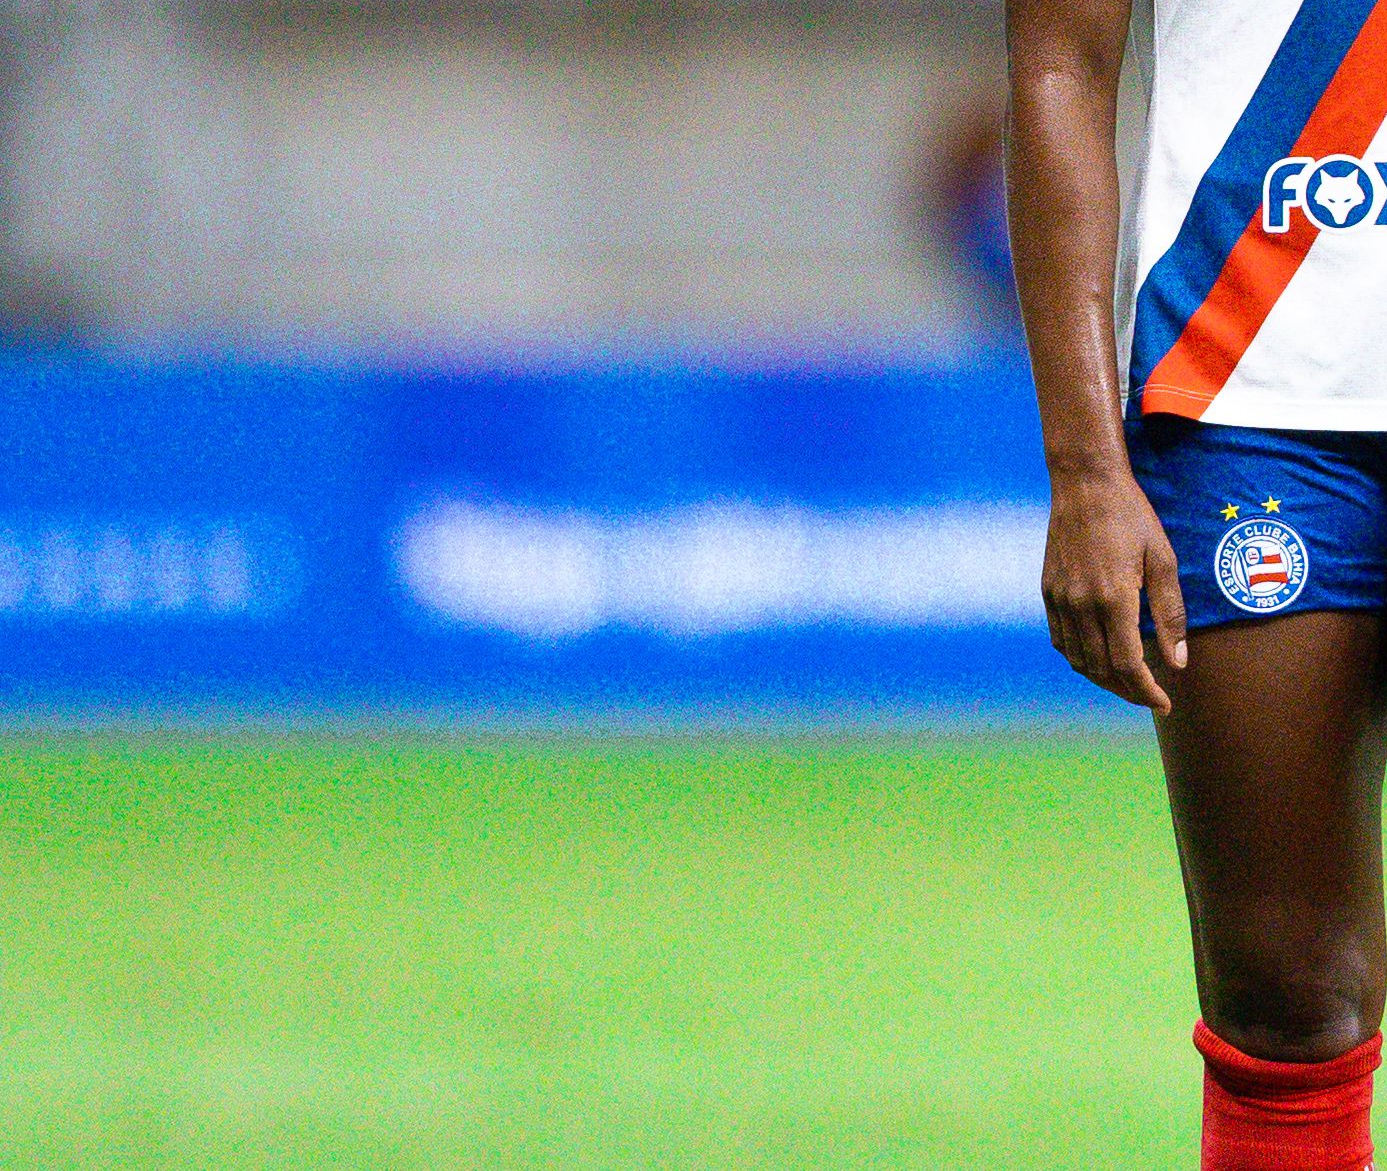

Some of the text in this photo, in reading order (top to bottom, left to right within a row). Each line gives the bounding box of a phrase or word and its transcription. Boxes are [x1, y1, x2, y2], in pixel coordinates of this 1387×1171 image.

[1220, 525, 1304, 595] ESPORTE CLUBE BAHIA
[1255, 595, 1280, 608] 1931
